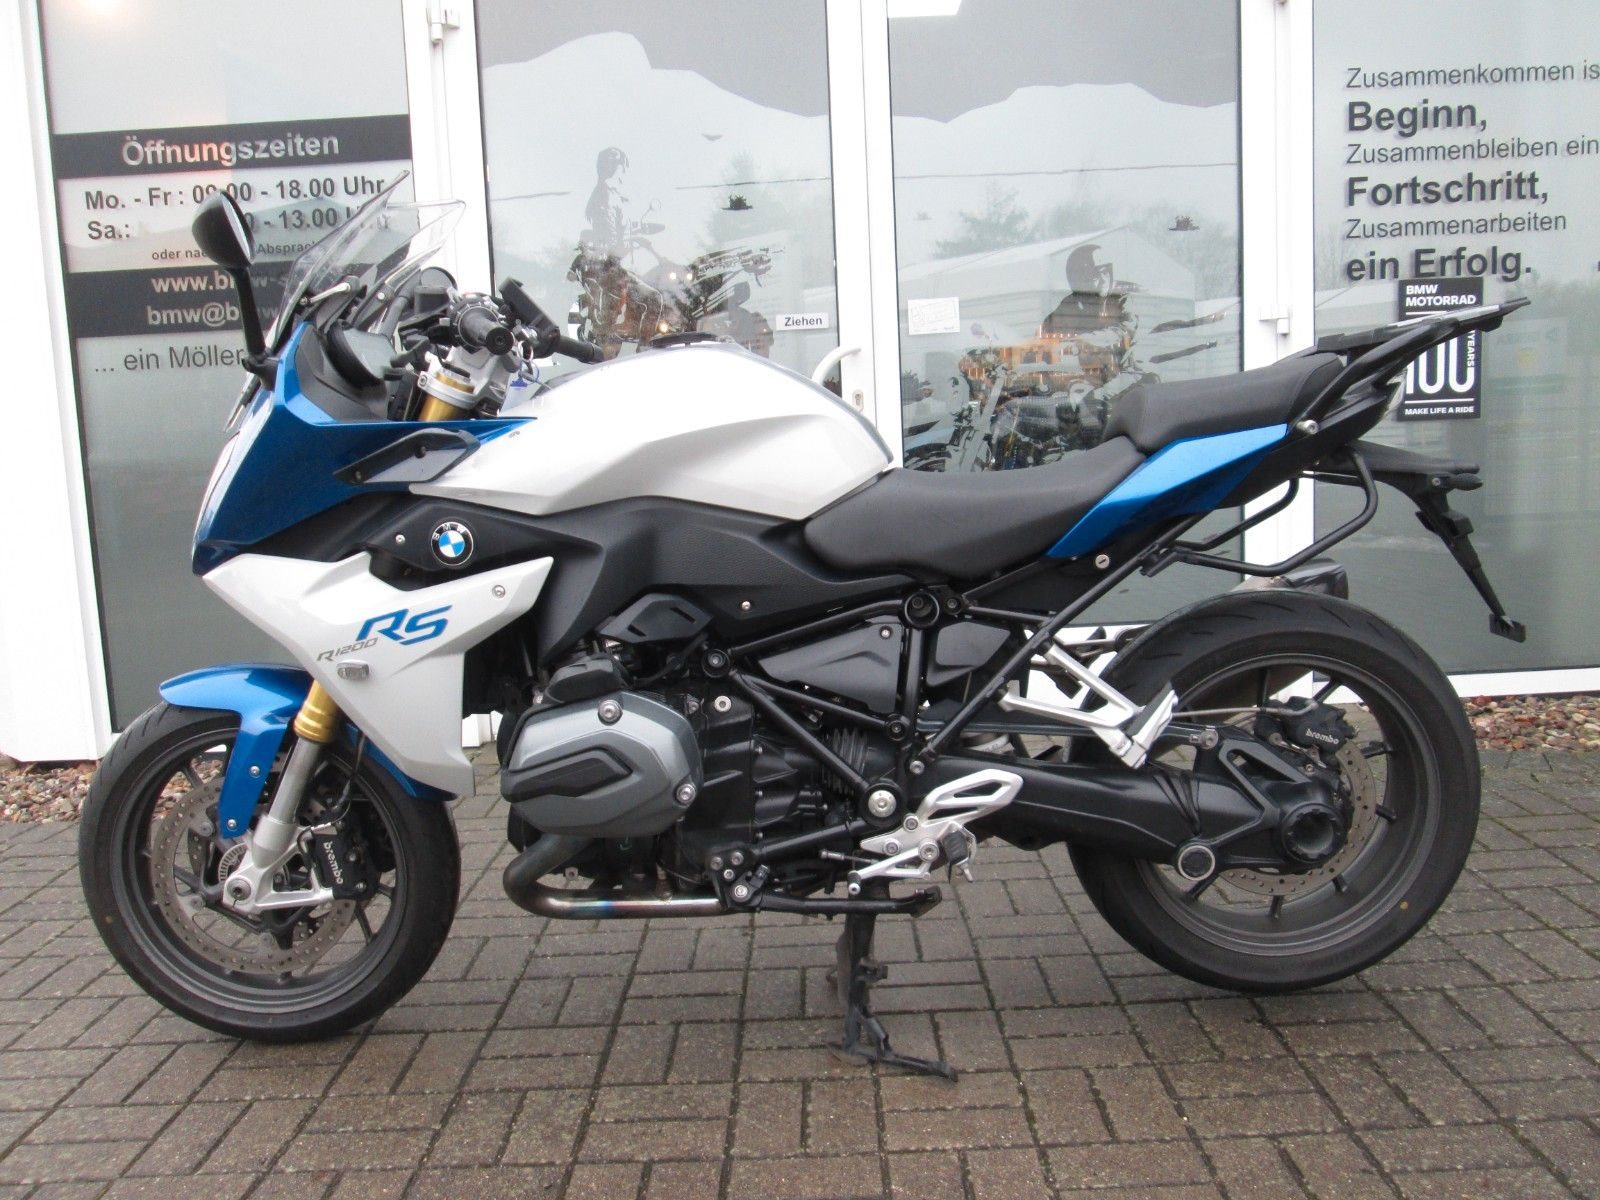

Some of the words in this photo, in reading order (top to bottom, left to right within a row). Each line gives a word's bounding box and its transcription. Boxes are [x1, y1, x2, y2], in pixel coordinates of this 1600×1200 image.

[1346, 63, 1574, 89] Zusammenkommen
[1348, 98, 1487, 137] Beginn,
[122, 134, 340, 167] Öffnungszeiten
[1346, 137, 1558, 164] Zusammenbleiben
[85, 190, 126, 210] Mo.
[275, 177, 335, 199] 18.00
[343, 175, 385, 196] Uhr
[1348, 171, 1549, 207] Fortschritt,
[87, 220, 131, 241] Sa.:
[278, 207, 338, 230] 13.00
[1346, 211, 1567, 239] Zusammenarbeiten
[151, 248, 181, 261] oder
[257, 240, 315, 256] Absprac
[1346, 250, 1400, 281] ein
[1414, 245, 1532, 283] Erfolg.
[1405, 294, 1477, 307] MOTORRAD
[1406, 284, 1439, 295] BMW
[784, 315, 823, 328] Ziehen
[124, 347, 160, 371] ein
[1466, 333, 1476, 367] YEARS
[1404, 407, 1429, 416] MAKE
[1430, 406, 1447, 415] LIFE
[1447, 406, 1455, 414] A
[1455, 405, 1475, 414] RIDE
[356, 604, 452, 646] RS
[316, 637, 379, 662] R1200
[1305, 728, 1340, 745] brembo
[323, 841, 344, 884] brembo
